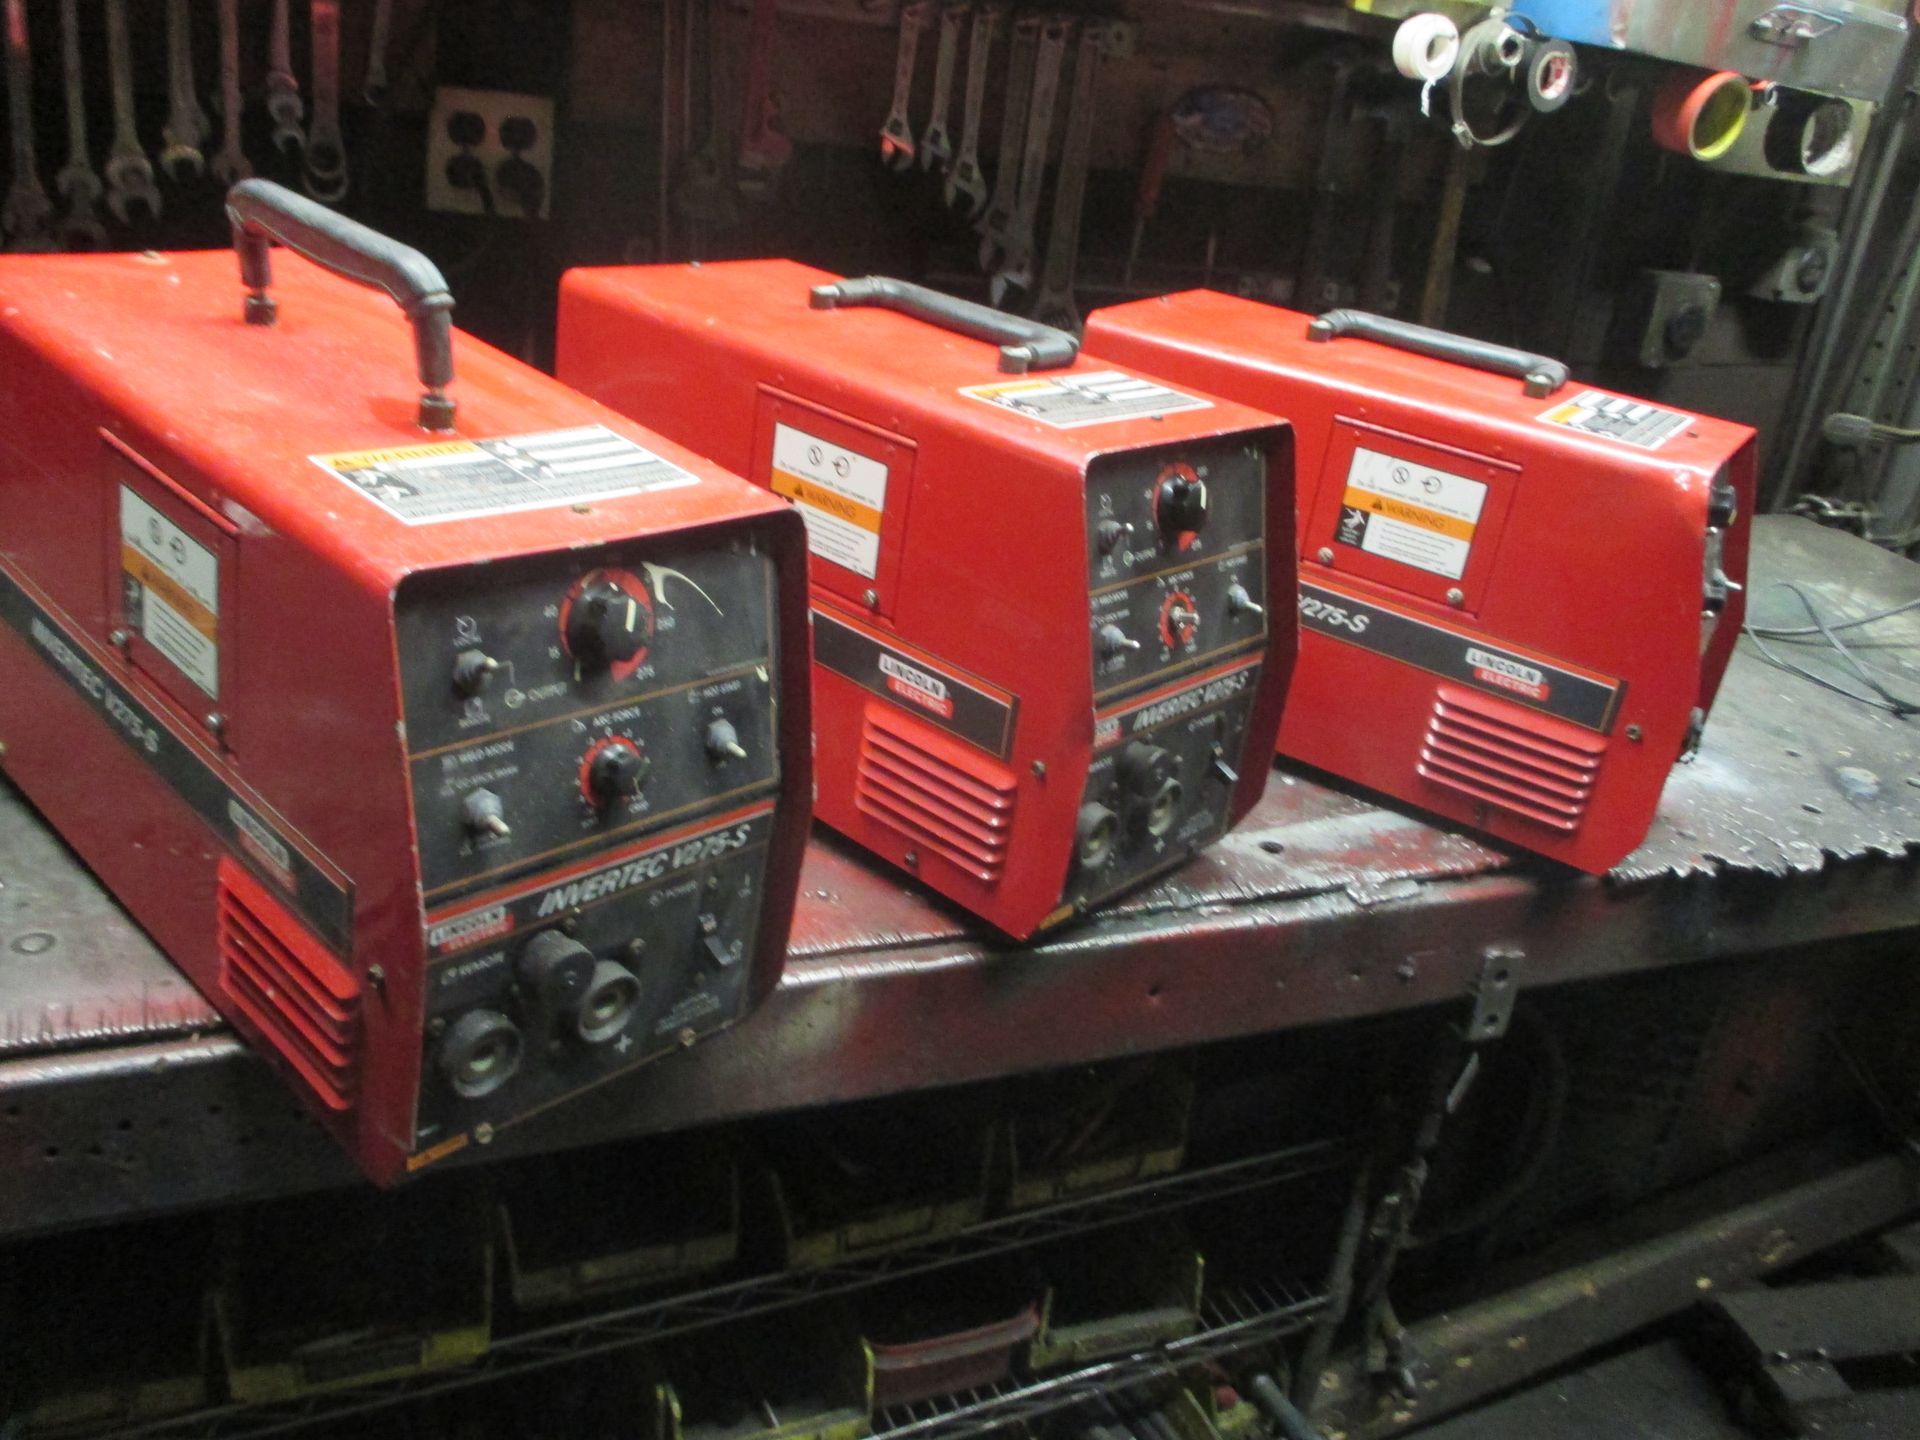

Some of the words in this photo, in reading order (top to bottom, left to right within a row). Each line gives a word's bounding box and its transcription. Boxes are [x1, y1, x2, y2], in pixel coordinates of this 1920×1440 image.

[1387, 502, 1445, 528] WARNING
[883, 658, 942, 696] LINCOLN
[1471, 652, 1537, 681] LINCOLN
[895, 682, 948, 717] ELECTRIC
[1481, 671, 1541, 697] ELECTRIC
[538, 852, 668, 916] INVERTEC
[673, 824, 751, 868] V275-S
